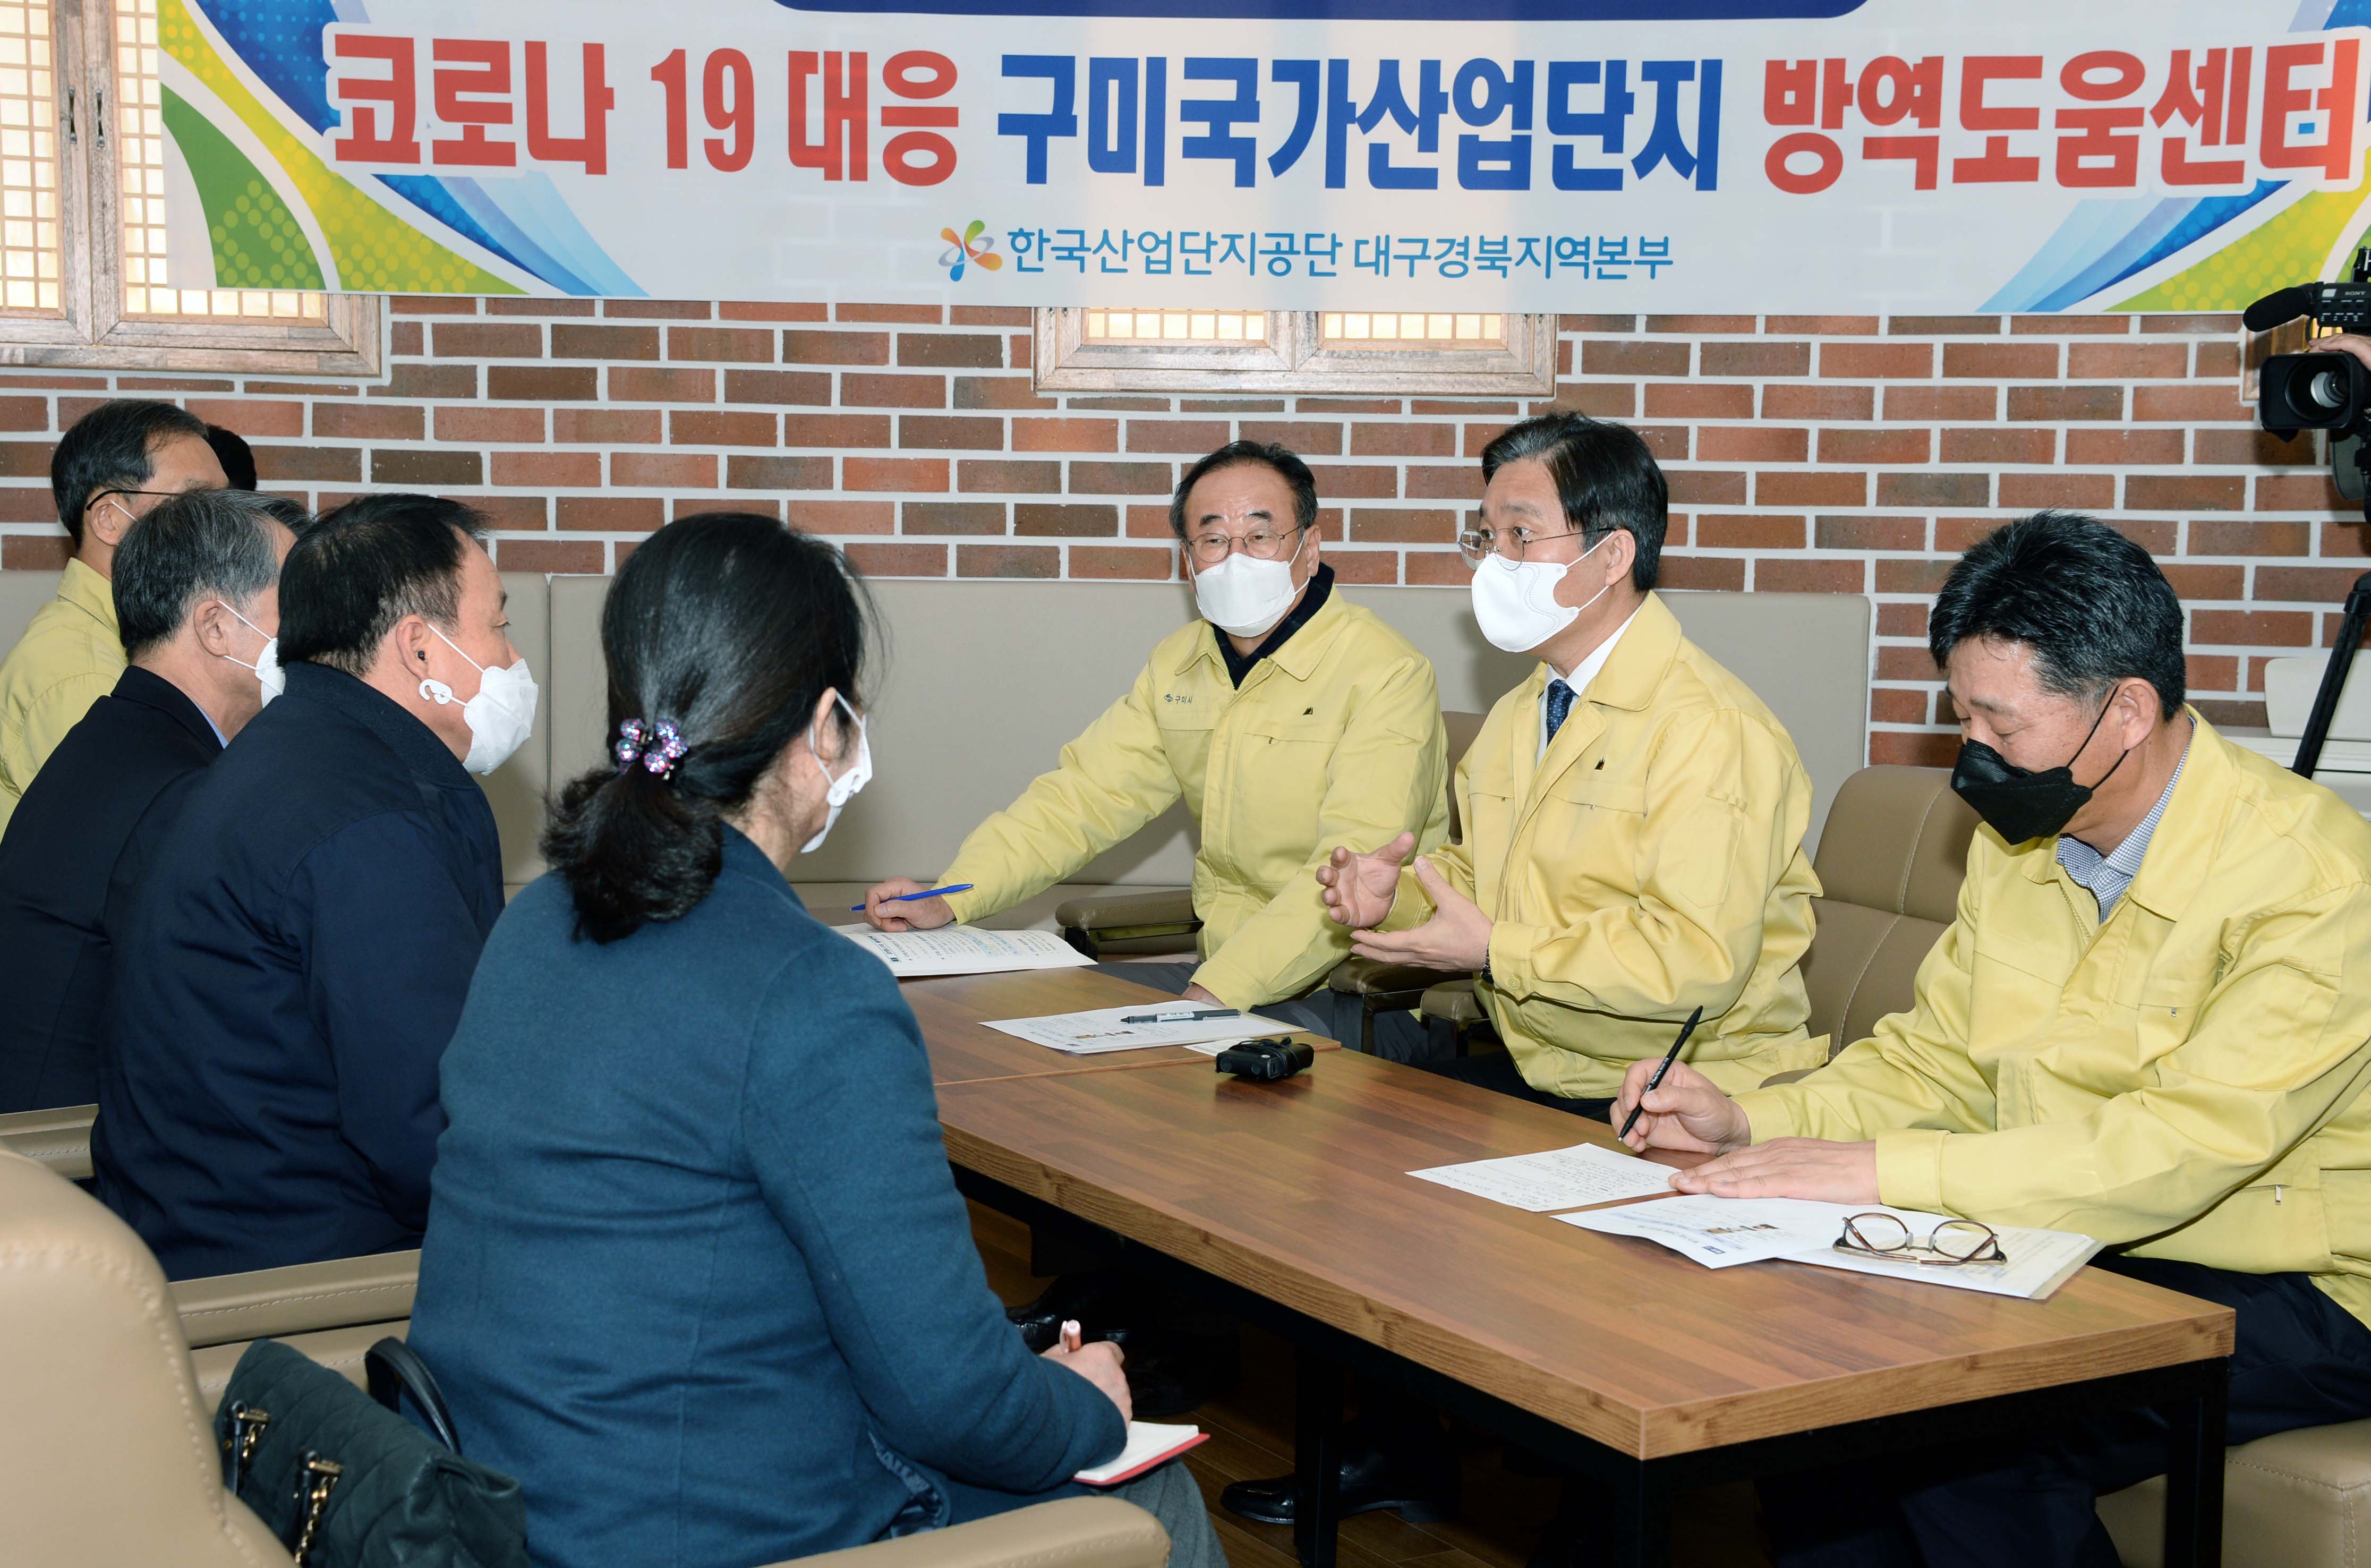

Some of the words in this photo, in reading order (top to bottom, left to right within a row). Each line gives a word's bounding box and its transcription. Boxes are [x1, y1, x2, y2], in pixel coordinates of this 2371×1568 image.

[336, 35, 613, 174] 코로나
[650, 49, 754, 171] 19
[787, 52, 958, 185] 대응
[997, 55, 1722, 192] 구미국가산업단지
[1763, 40, 2359, 193] 방역도움센터
[1008, 228, 1342, 276] 한국산업단지공단
[1355, 235, 1673, 279] 대구경북지역본부
[1174, 695, 1192, 705] 구미시
